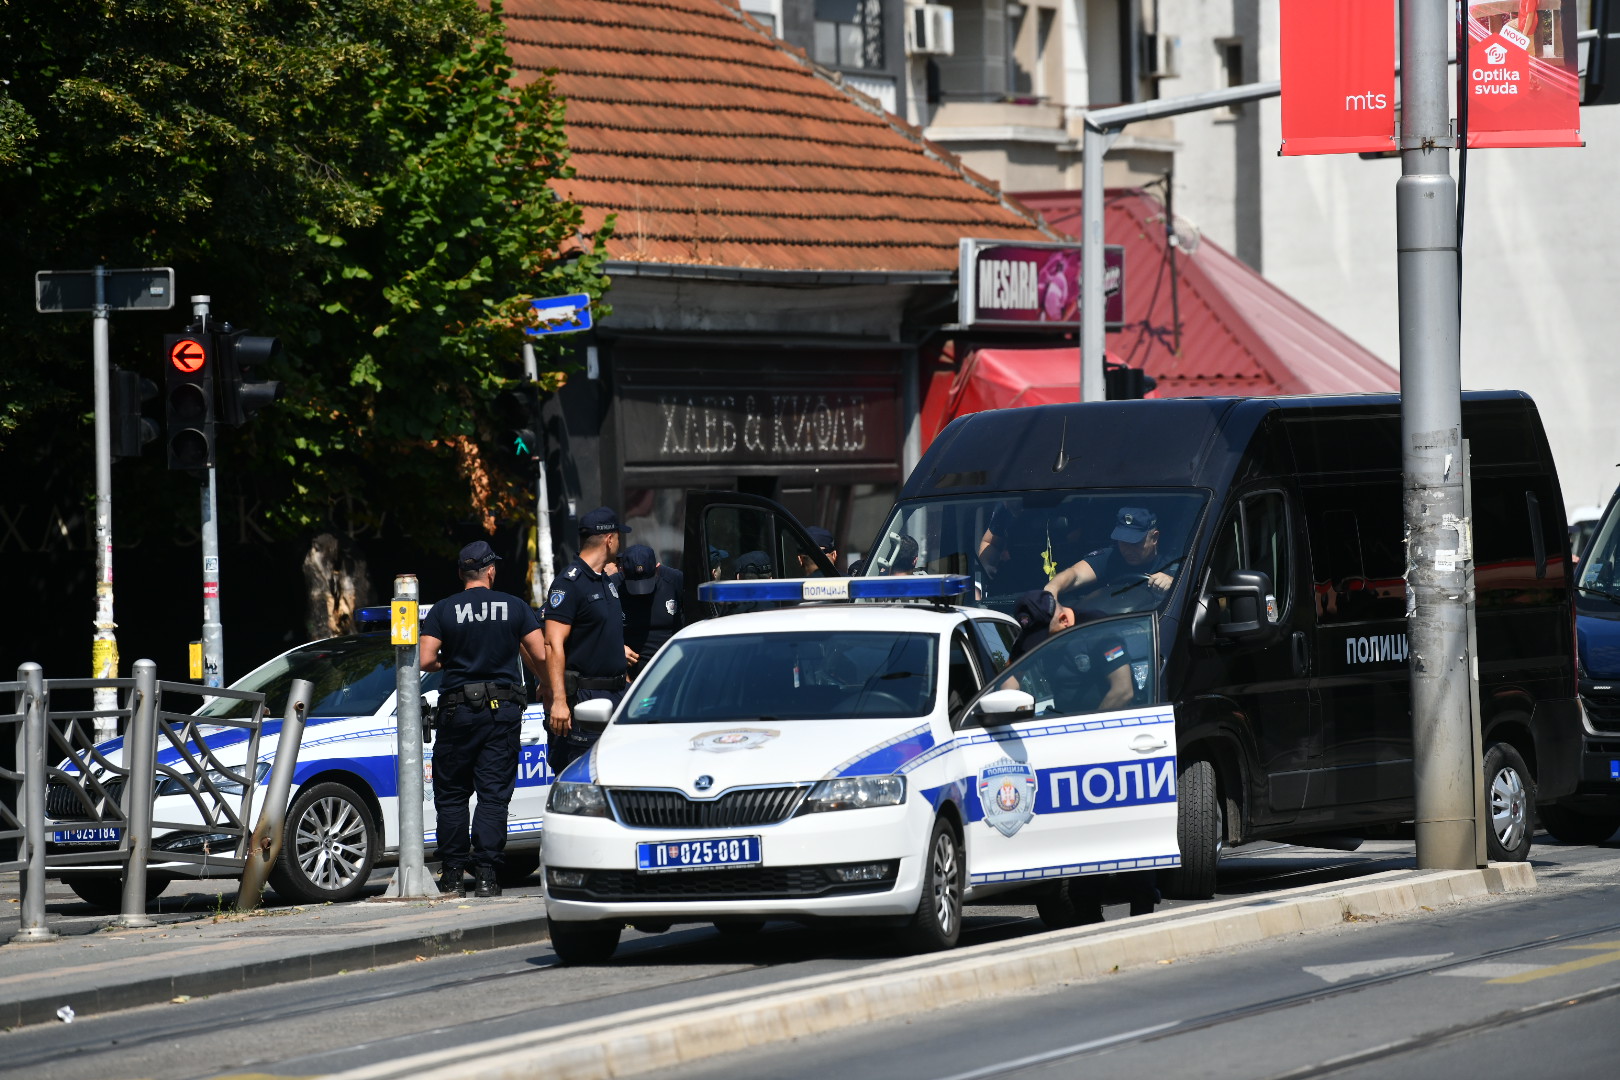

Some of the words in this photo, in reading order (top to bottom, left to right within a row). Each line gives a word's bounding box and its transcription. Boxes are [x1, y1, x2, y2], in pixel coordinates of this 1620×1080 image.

[1503, 28, 1527, 46] NOVO
[1472, 68, 1520, 82] Optika
[1475, 81, 1518, 94] svuda
[1345, 90, 1387, 110] mts
[979, 259, 1039, 310] MESARA
[454, 601, 508, 624] ИЈП
[987, 765, 1025, 776] ПОЛИЦИЈА
[1049, 760, 1176, 809] ПОЛИ
[657, 845, 668, 866] П
